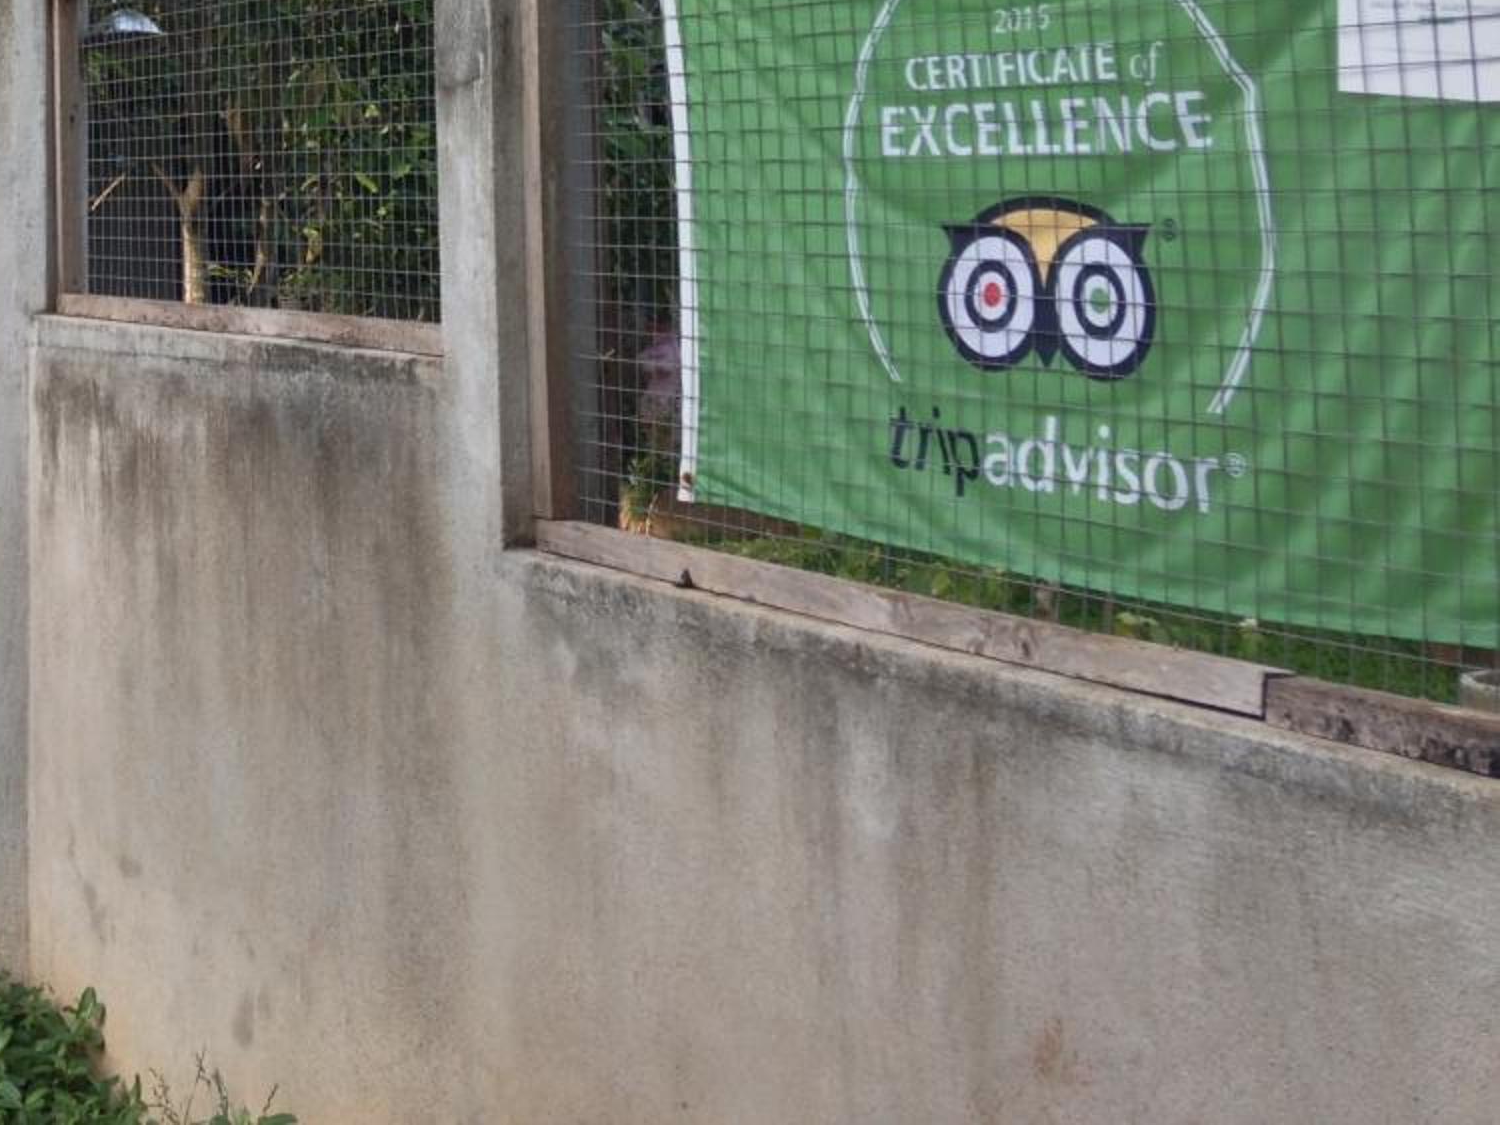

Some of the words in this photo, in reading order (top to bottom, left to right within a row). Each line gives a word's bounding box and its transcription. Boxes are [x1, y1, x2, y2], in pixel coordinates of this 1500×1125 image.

[994, 4, 1051, 34] 2015
[905, 42, 1117, 91] CERTIFICATE
[1130, 41, 1164, 86] of
[881, 91, 1213, 157] EXCELLENCE
